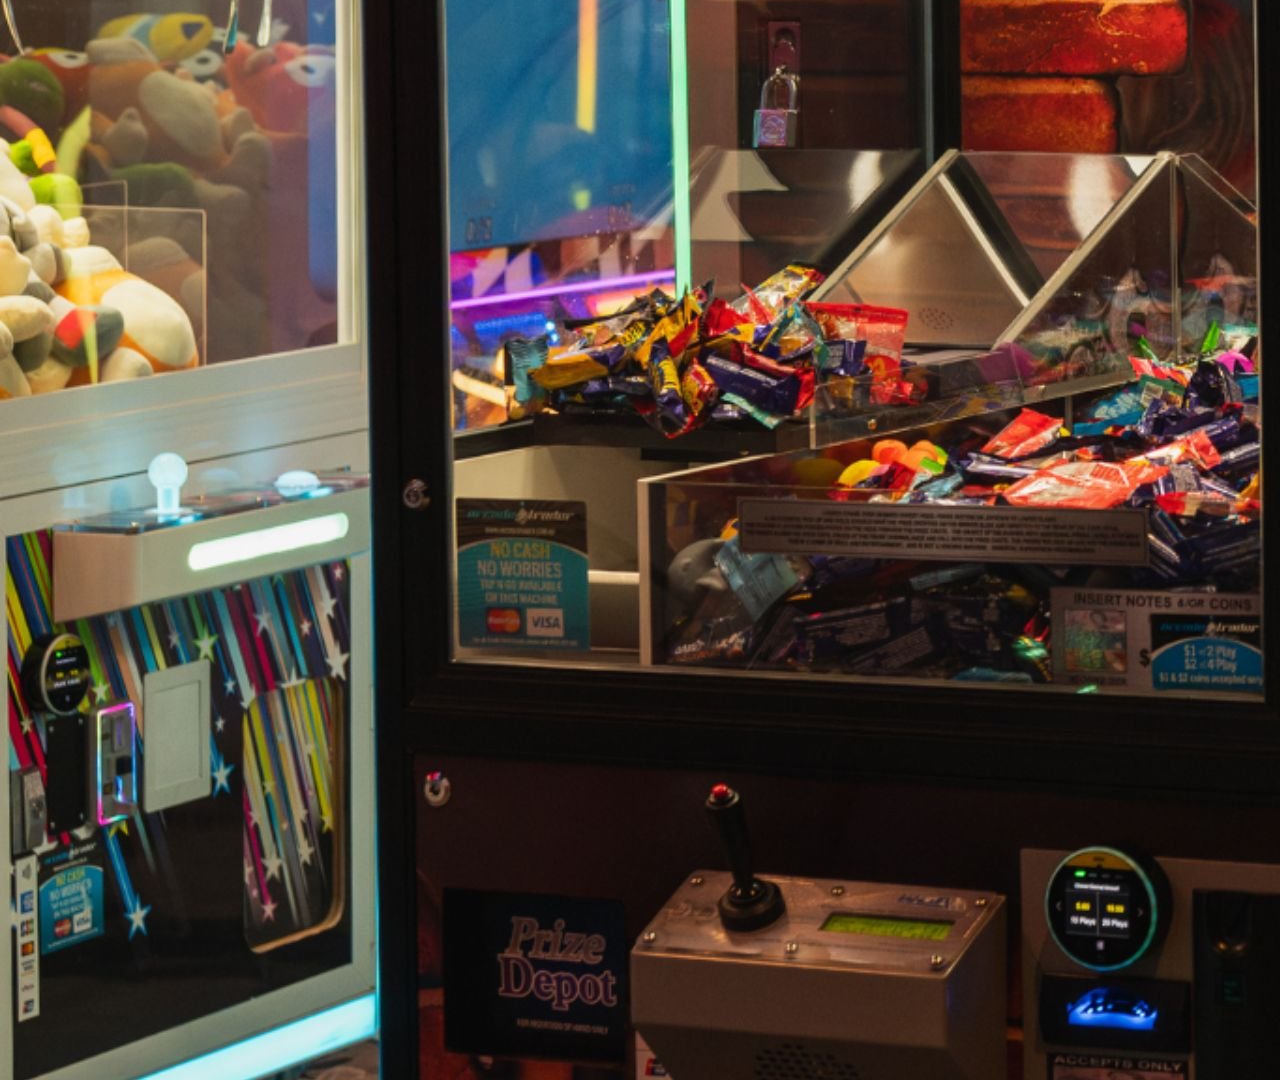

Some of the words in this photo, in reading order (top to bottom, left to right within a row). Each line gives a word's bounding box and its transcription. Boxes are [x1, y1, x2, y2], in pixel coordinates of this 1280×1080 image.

[477, 559, 497, 577] NO
[500, 559, 562, 579] WORRIES
[1073, 592, 1121, 608] INSERT
[1126, 594, 1171, 608] NOTES
[1208, 598, 1253, 611] COINS
[532, 616, 561, 629] VISA
[504, 916, 608, 966] Prize
[497, 953, 619, 1012] Depot
[1055, 1054, 1134, 1070] ACCEPTS
[1137, 1060, 1183, 1073] ONLY
